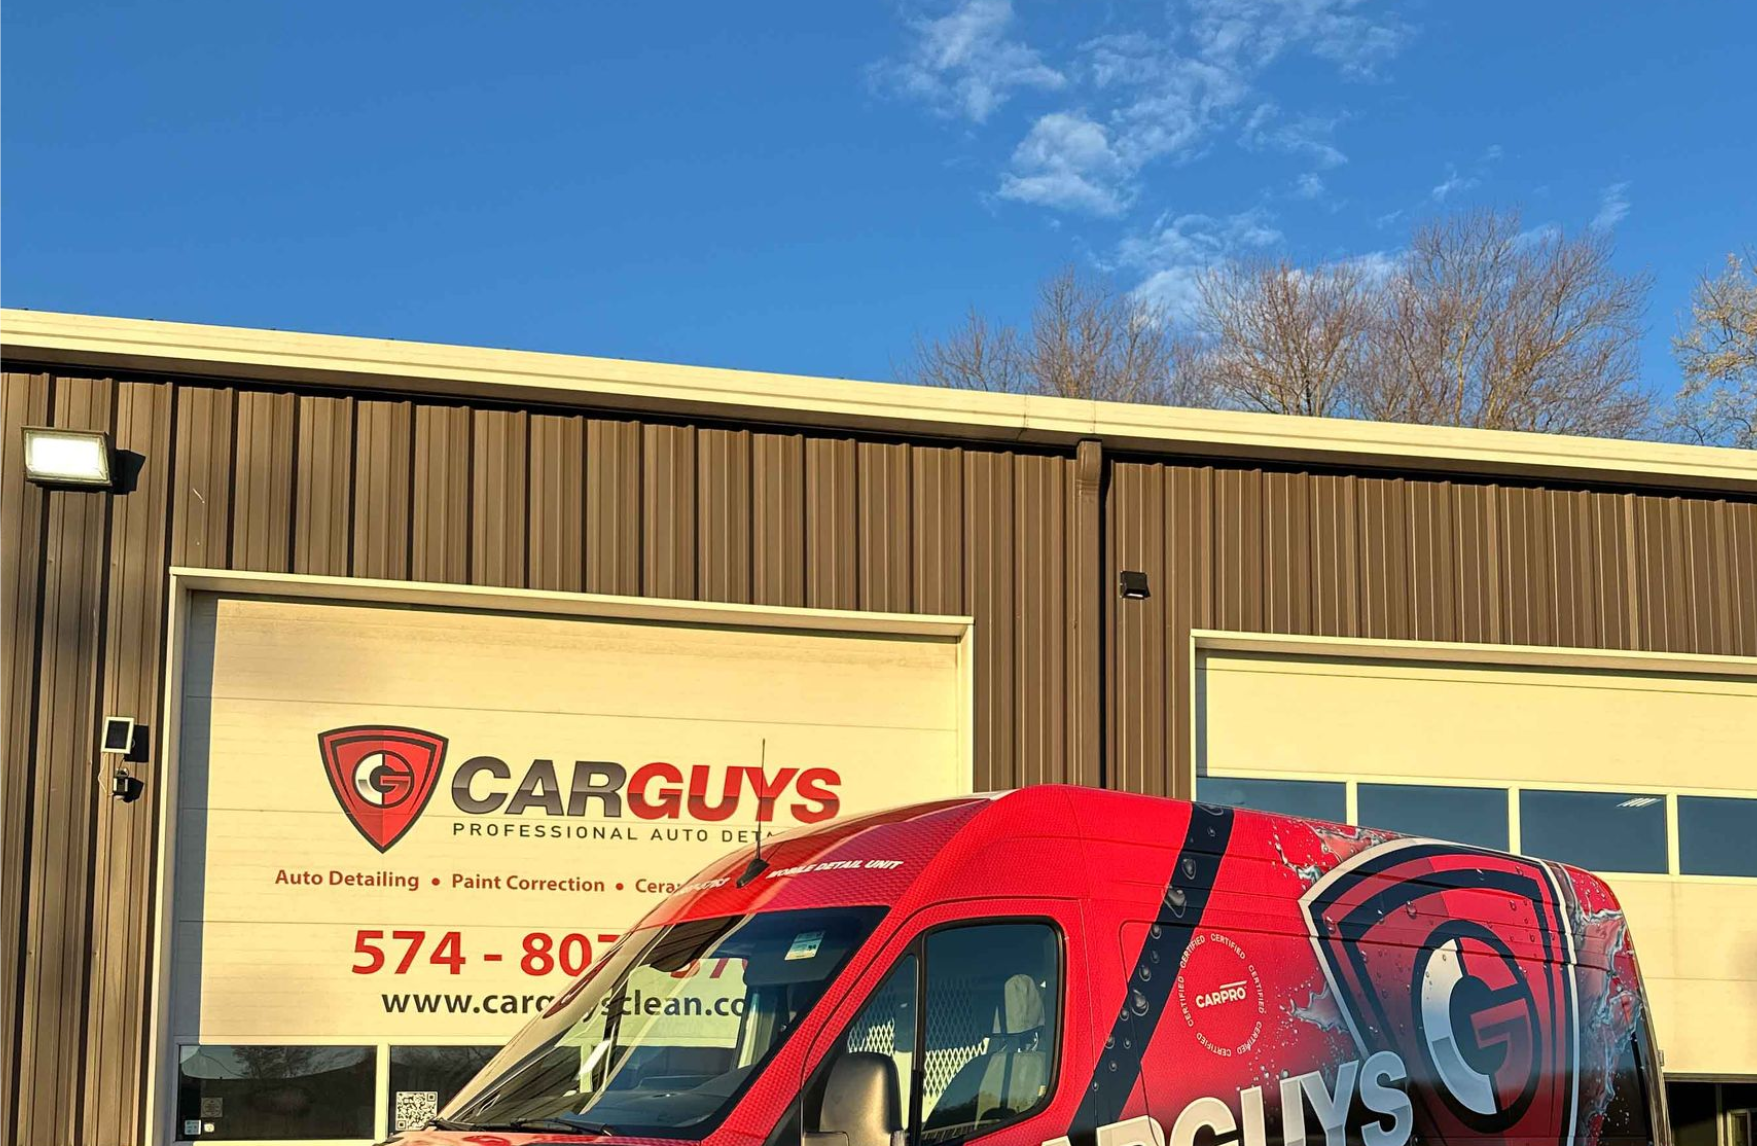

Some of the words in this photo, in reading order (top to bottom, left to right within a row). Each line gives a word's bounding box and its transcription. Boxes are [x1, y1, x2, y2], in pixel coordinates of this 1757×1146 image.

[451, 755, 842, 824] CARGUYS
[452, 822, 638, 841] PROFESSIONAL
[650, 828, 709, 843] AUTO
[814, 859, 863, 871] DETAIL
[864, 859, 904, 870] UNIT
[275, 869, 324, 886] Auto
[328, 870, 420, 892] Detailing
[451, 873, 502, 890] Paint
[506, 875, 606, 892] Correction
[635, 878, 680, 894] Cera
[351, 929, 467, 975] 574
[1180, 934, 1206, 969] CERTIFIED
[1210, 932, 1246, 960] CERTIFIED
[1177, 975, 1194, 1027] CERTIFIED
[1195, 986, 1246, 1008] CARPRO
[1248, 964, 1265, 1014] CERTIFIED
[1196, 1032, 1232, 1057] CERTIFIED
[1237, 1020, 1263, 1055] CERTIFIED
